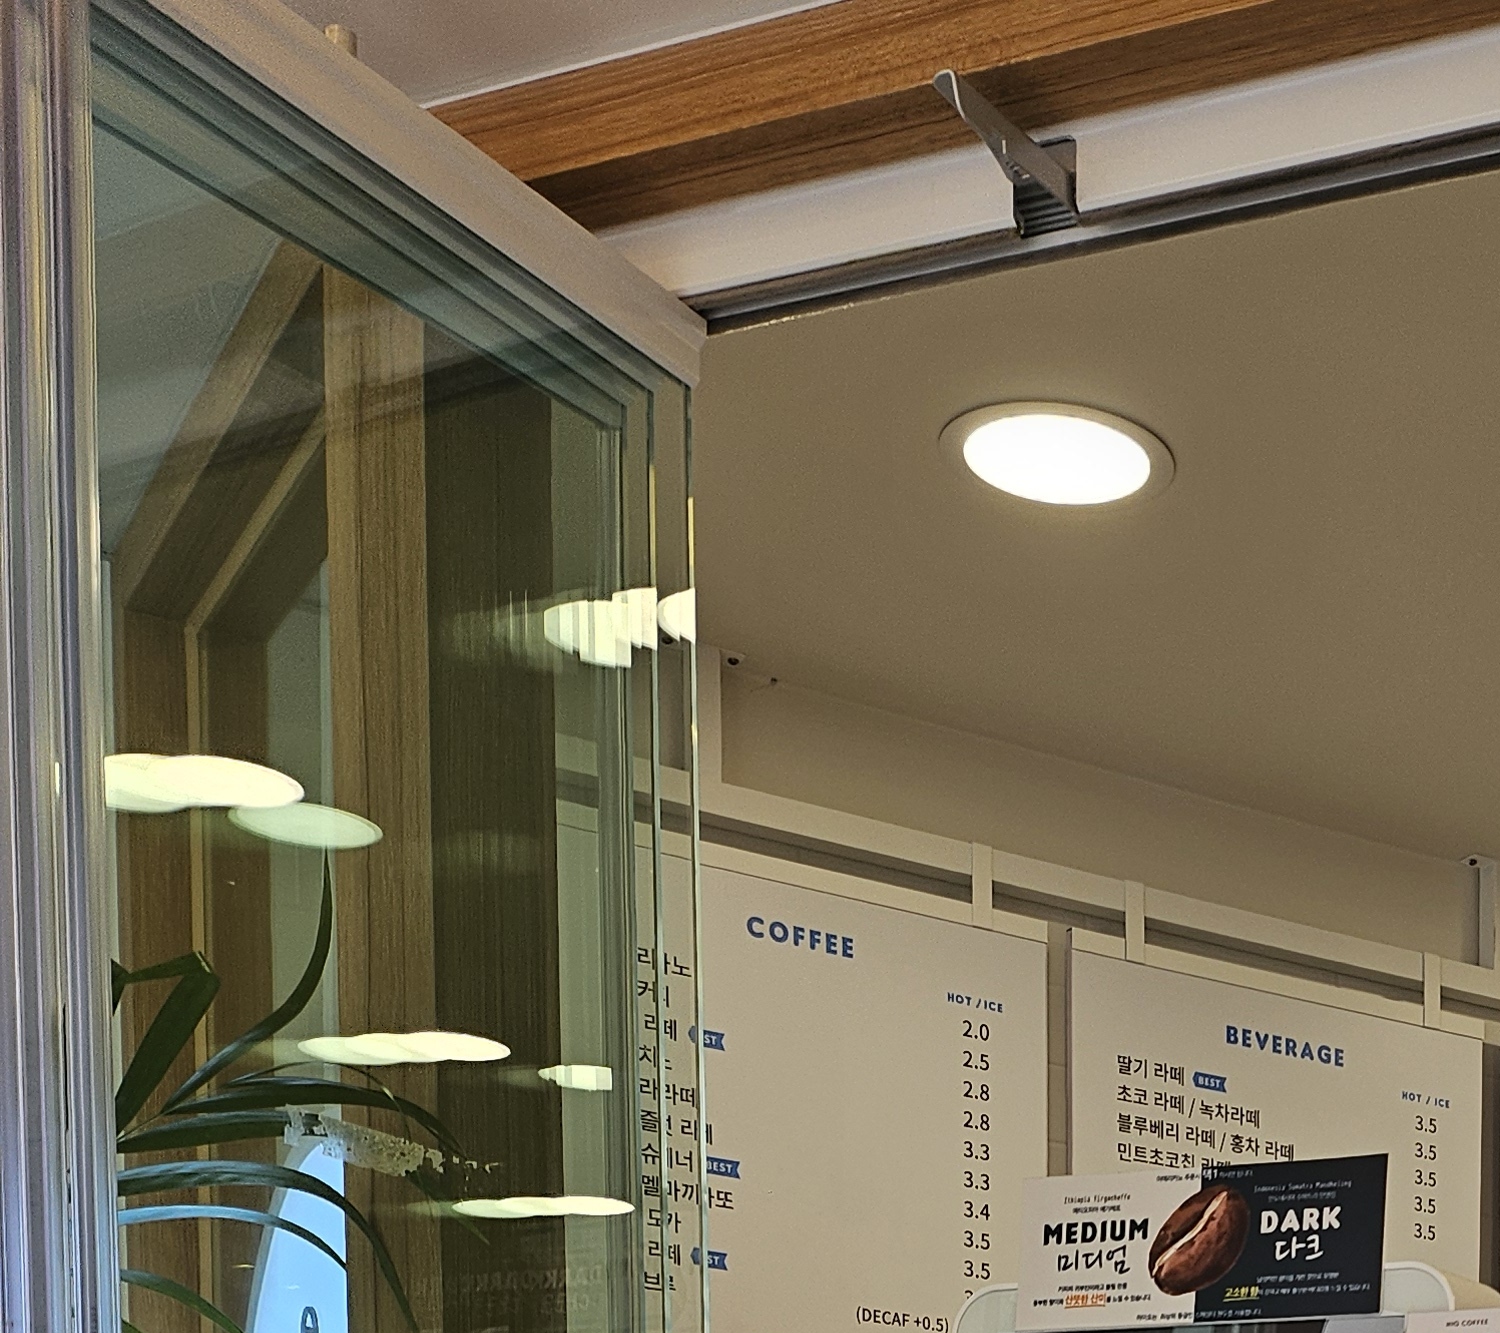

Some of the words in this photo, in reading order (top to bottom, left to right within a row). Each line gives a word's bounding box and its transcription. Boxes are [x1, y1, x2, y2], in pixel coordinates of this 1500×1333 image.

[746, 916, 855, 959] COFFEE
[962, 1020, 990, 1041] 2.0
[1226, 1025, 1345, 1067] BEVERAGE
[1117, 1055, 1148, 1078] 딸기
[1153, 1063, 1185, 1086] 라떼
[1197, 1075, 1221, 1088] BEST
[962, 1080, 991, 1102] 2.8
[1402, 1092, 1421, 1103] HOT
[1434, 1098, 1450, 1109] ICE
[1117, 1086, 1148, 1106] 초코
[1153, 1092, 1185, 1115] 라떼
[1200, 1100, 1261, 1128] 녹차라떼
[1414, 1116, 1437, 1134] 3.5
[963, 1199, 991, 1221] 3.4
[1260, 1206, 1342, 1234] DARK
[1043, 1218, 1149, 1246] MEDIUM
[855, 1306, 909, 1331] (DECAF
